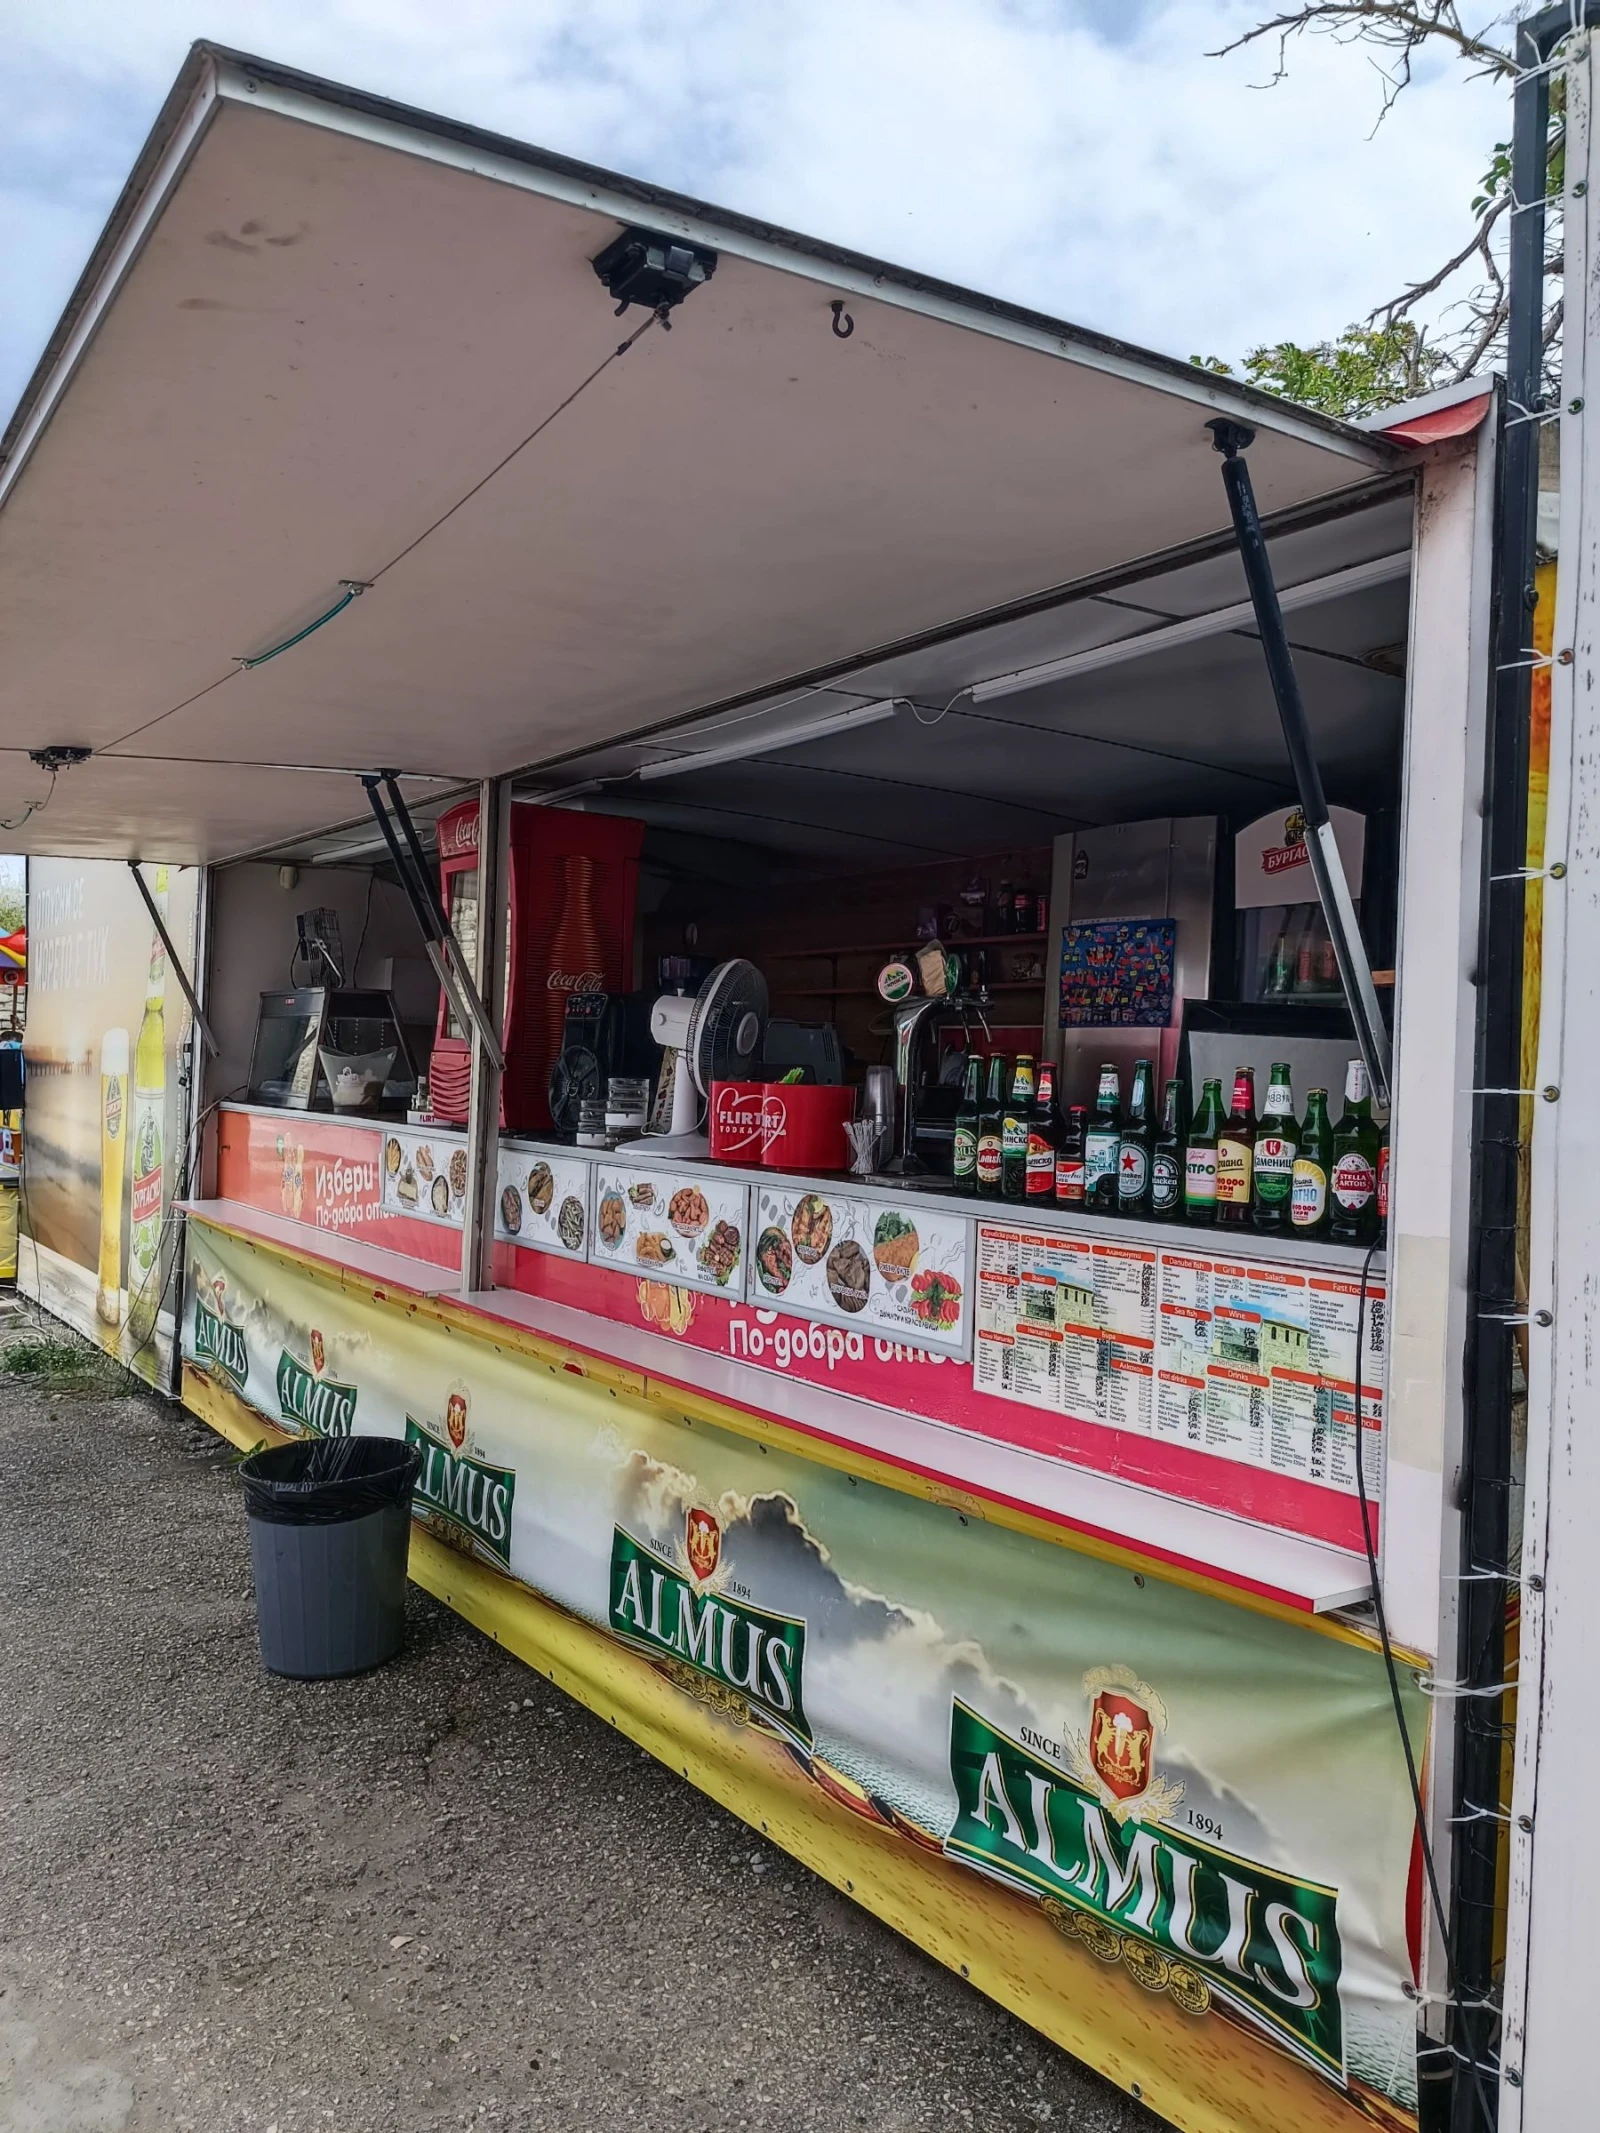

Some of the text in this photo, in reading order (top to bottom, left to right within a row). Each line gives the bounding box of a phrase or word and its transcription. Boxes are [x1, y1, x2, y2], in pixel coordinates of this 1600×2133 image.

[73, 877, 84, 920] СЕ
[34, 934, 72, 992] МОРЕТО
[315, 1157, 373, 1207] Избери
[1340, 1173, 1367, 1181] STELLA
[316, 1199, 363, 1231] По-добра
[1169, 1257, 1205, 1270] Danube fish
[1222, 1265, 1237, 1275] Grill
[1264, 1273, 1287, 1283] Salads
[1332, 1283, 1348, 1292] Fast
[1174, 1307, 1198, 1318] Sea fish
[1228, 1310, 1246, 1319] Wine
[1101, 1331, 1116, 1340] Бира
[729, 1319, 864, 1370] По-добра
[1120, 1362, 1144, 1373] Алкохол
[1160, 1371, 1188, 1384] Hot drinks
[1228, 1370, 1249, 1381] Drinks
[1321, 1377, 1338, 1388] Beer
[281, 1366, 352, 1438] ALMUS
[650, 1538, 672, 1558] SINCE
[732, 1581, 751, 1599] 1894
[615, 1559, 794, 1712] ALMUS
[1019, 1726, 1061, 1759] SINCE
[1186, 1808, 1223, 1841] 1894
[970, 1752, 1321, 2010] ALMUS
